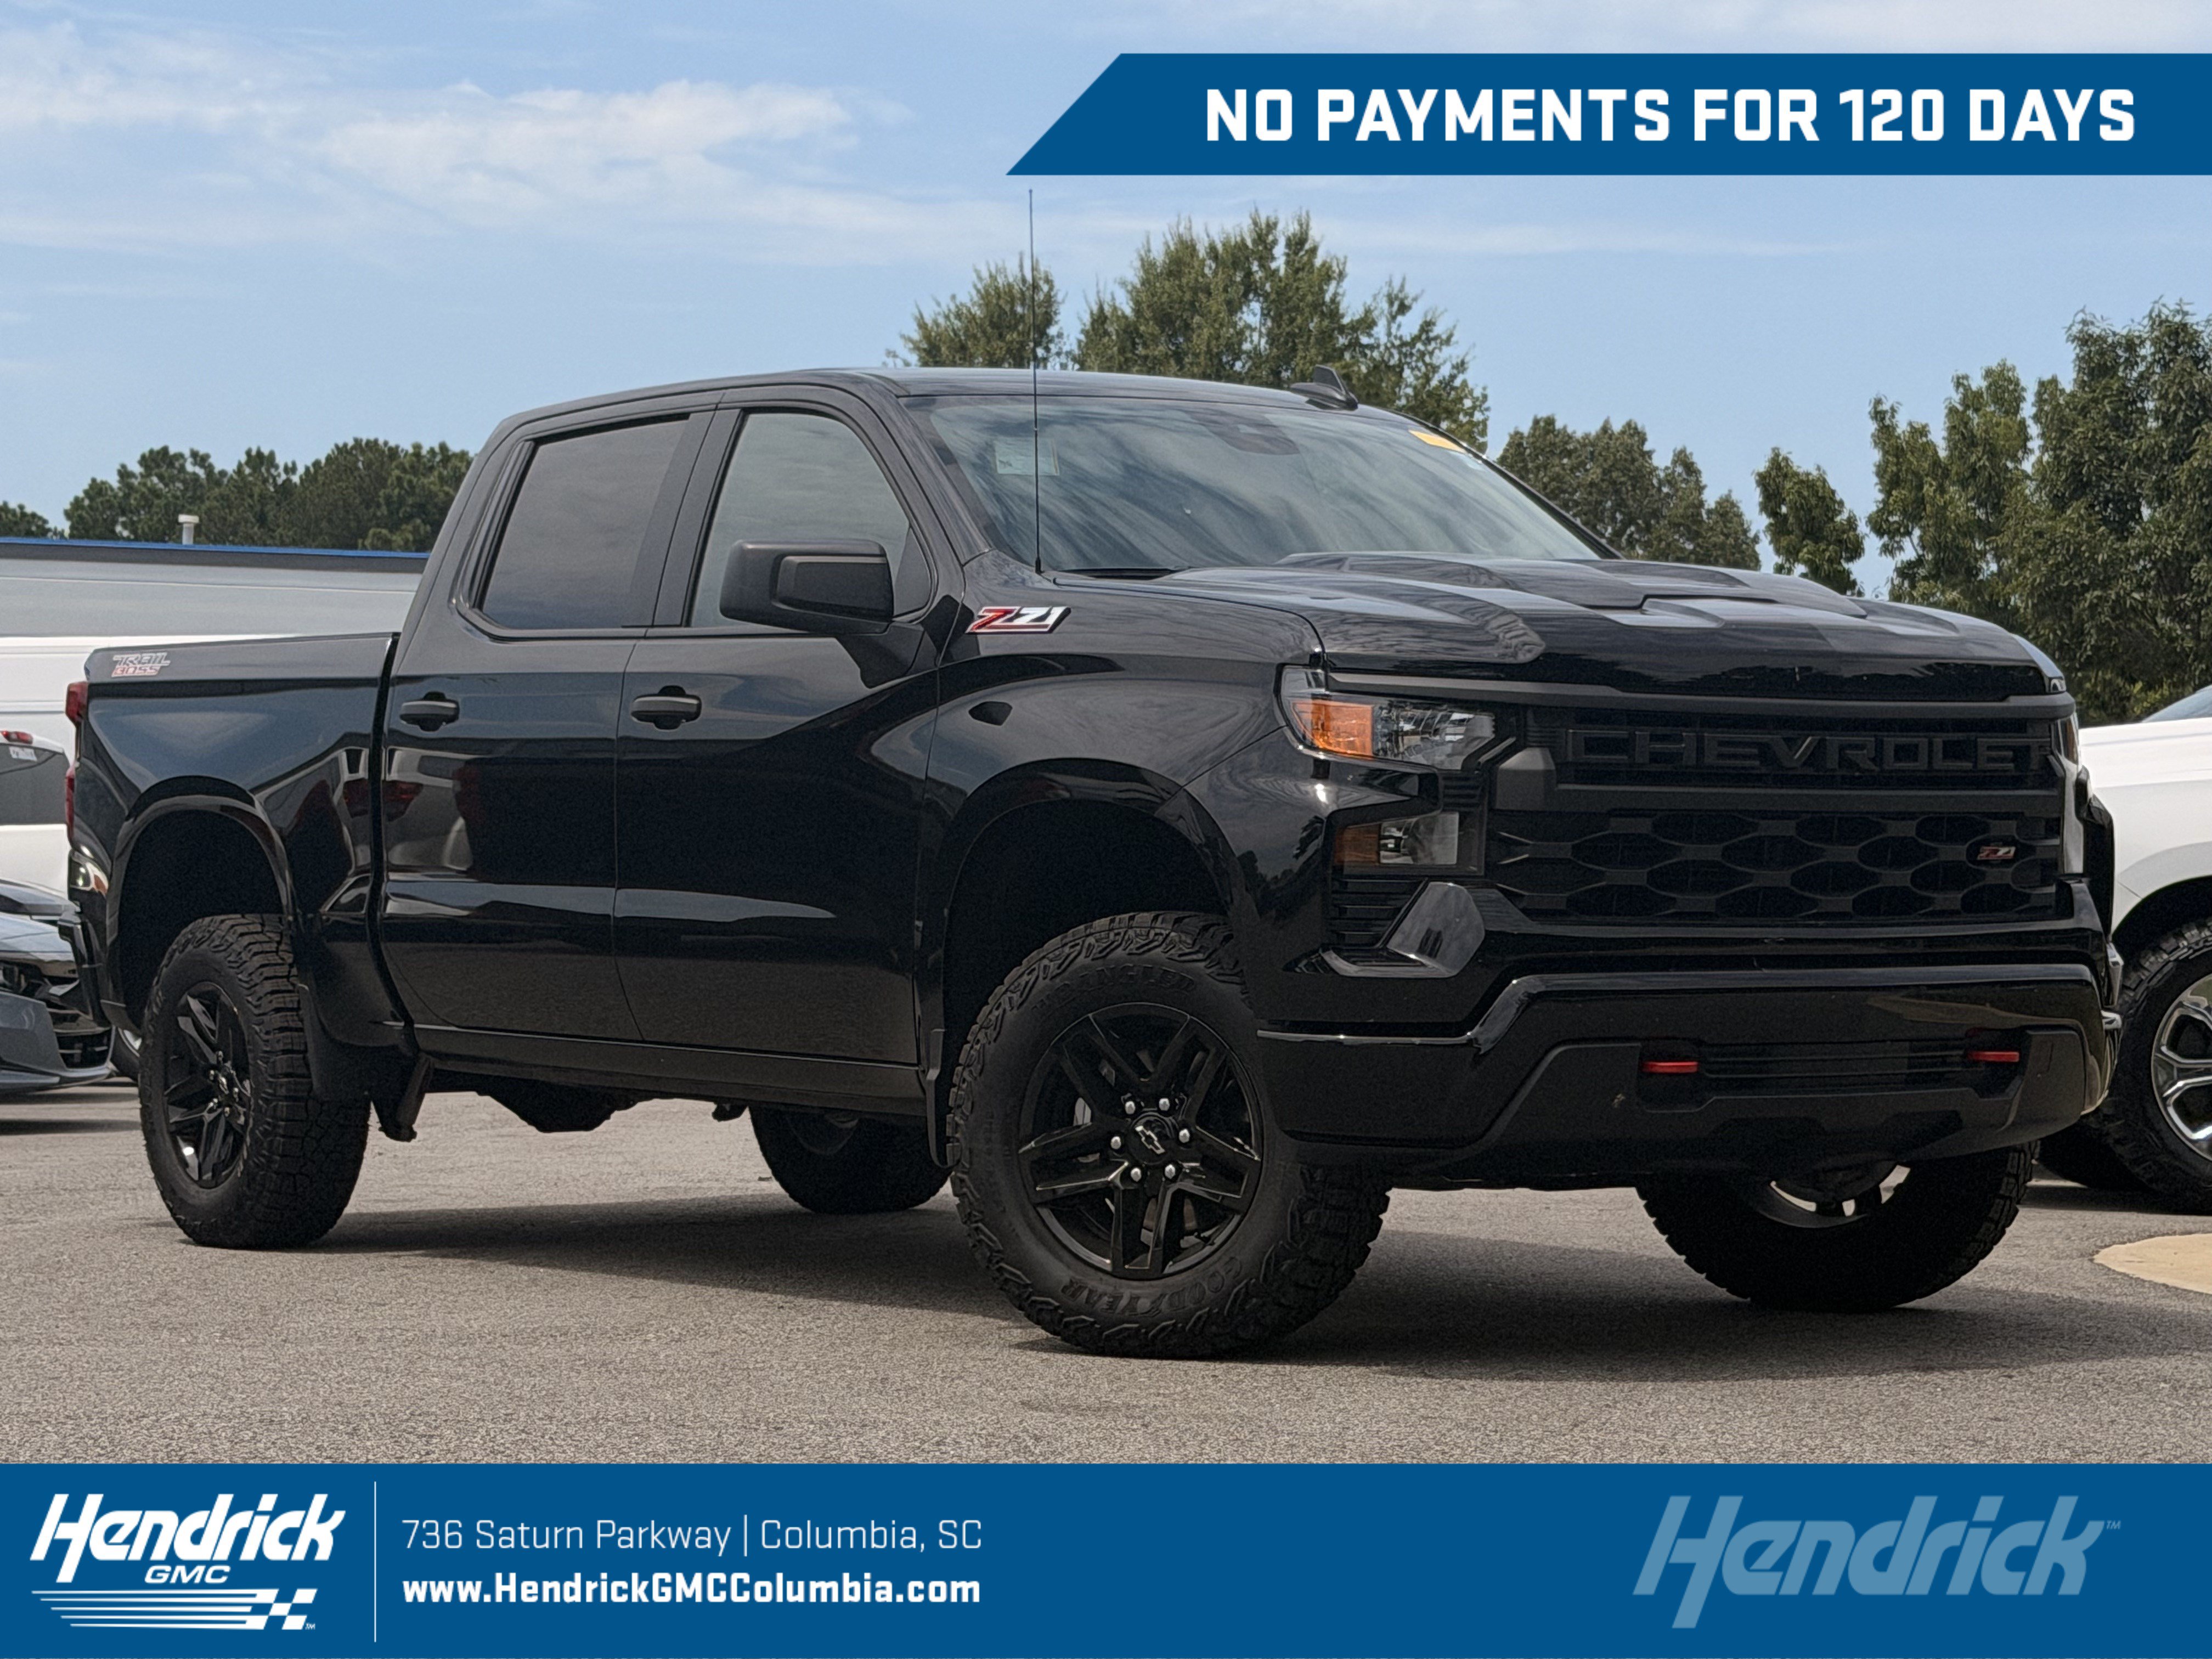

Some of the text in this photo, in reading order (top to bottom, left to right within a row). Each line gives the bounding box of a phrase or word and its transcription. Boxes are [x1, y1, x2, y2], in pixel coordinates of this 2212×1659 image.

[965, 606, 1070, 634] Z71
[112, 652, 171, 667] TRAIL
[111, 665, 161, 678] BOSS
[1567, 729, 2051, 771] CHEVROLET
